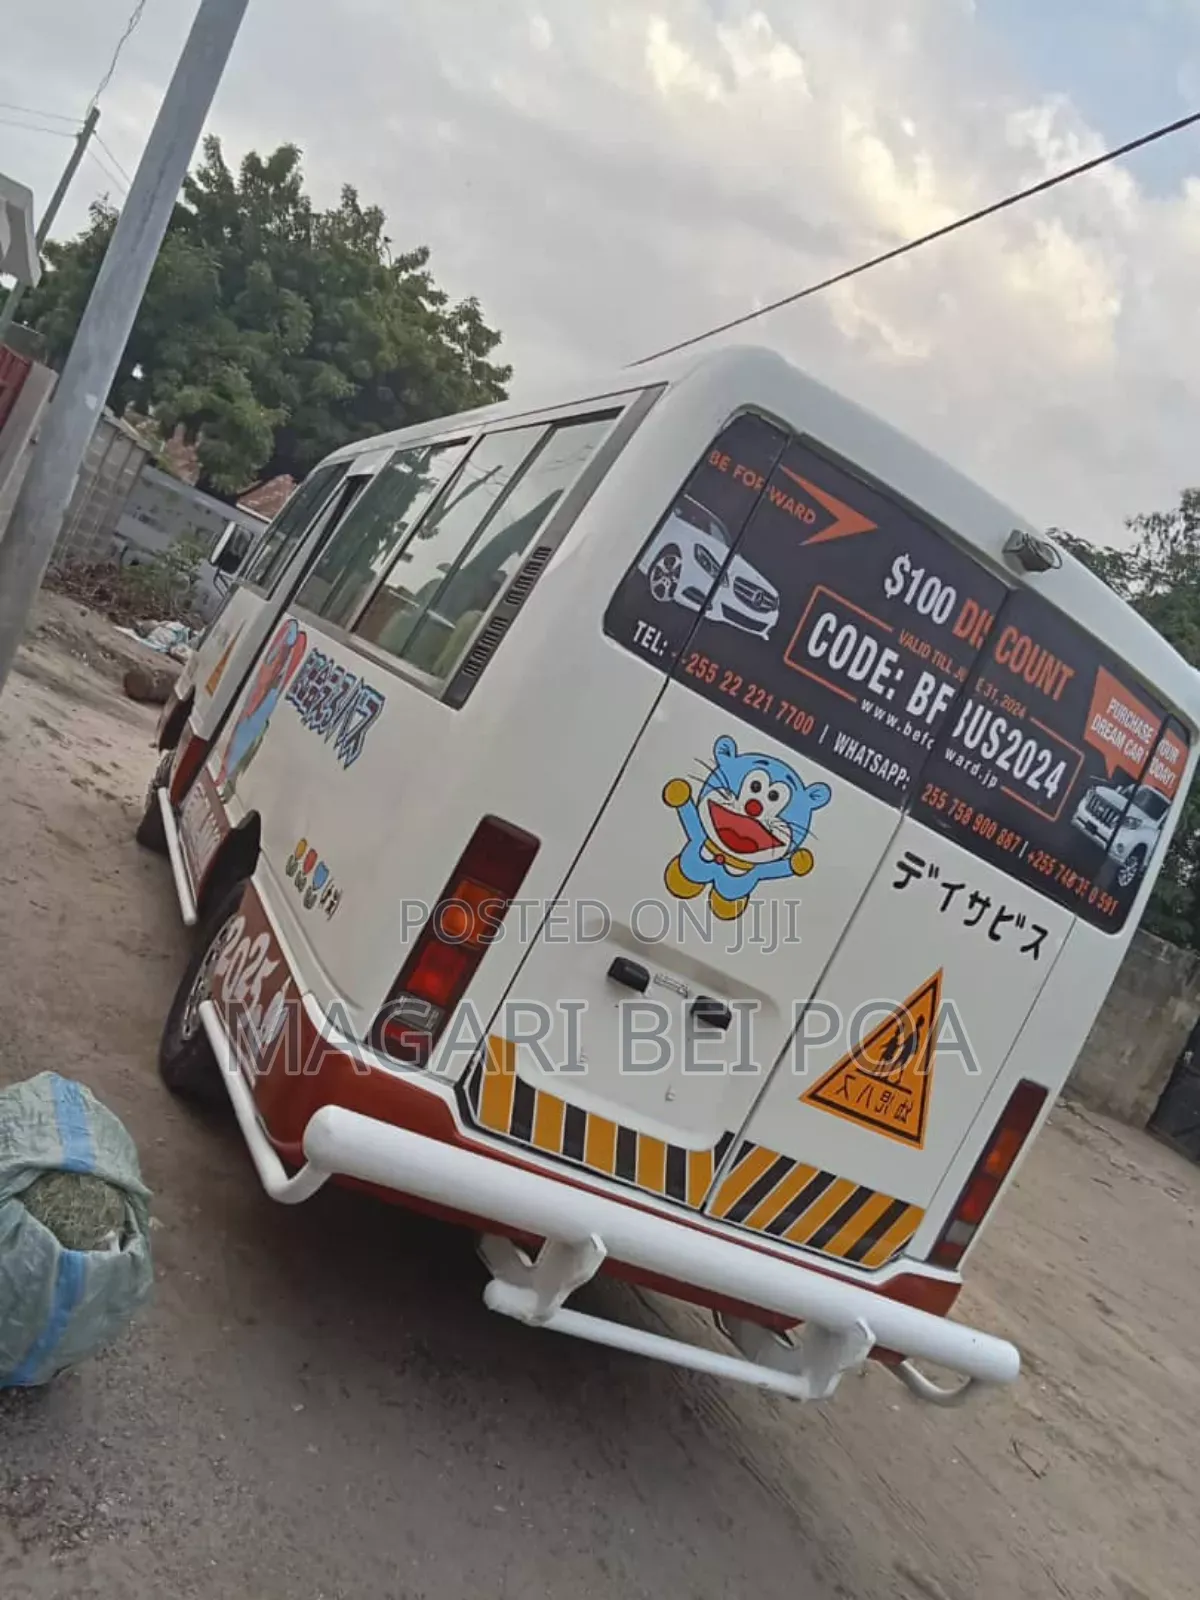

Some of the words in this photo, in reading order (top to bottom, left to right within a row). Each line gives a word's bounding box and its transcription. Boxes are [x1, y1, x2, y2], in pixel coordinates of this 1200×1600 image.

[708, 450, 731, 472] BE
[884, 553, 957, 624] $100
[807, 612, 904, 700] CODE:
[898, 628, 931, 658] VALID
[633, 620, 668, 656] TEL:
[718, 671, 743, 698] 22
[742, 684, 774, 714] 221
[775, 701, 815, 736] 7700
[834, 731, 911, 791] WHATSAPP:
[1106, 696, 1154, 744] PURCHASE
[1091, 713, 1126, 753] DREAM
[1124, 738, 1145, 765] CAR
